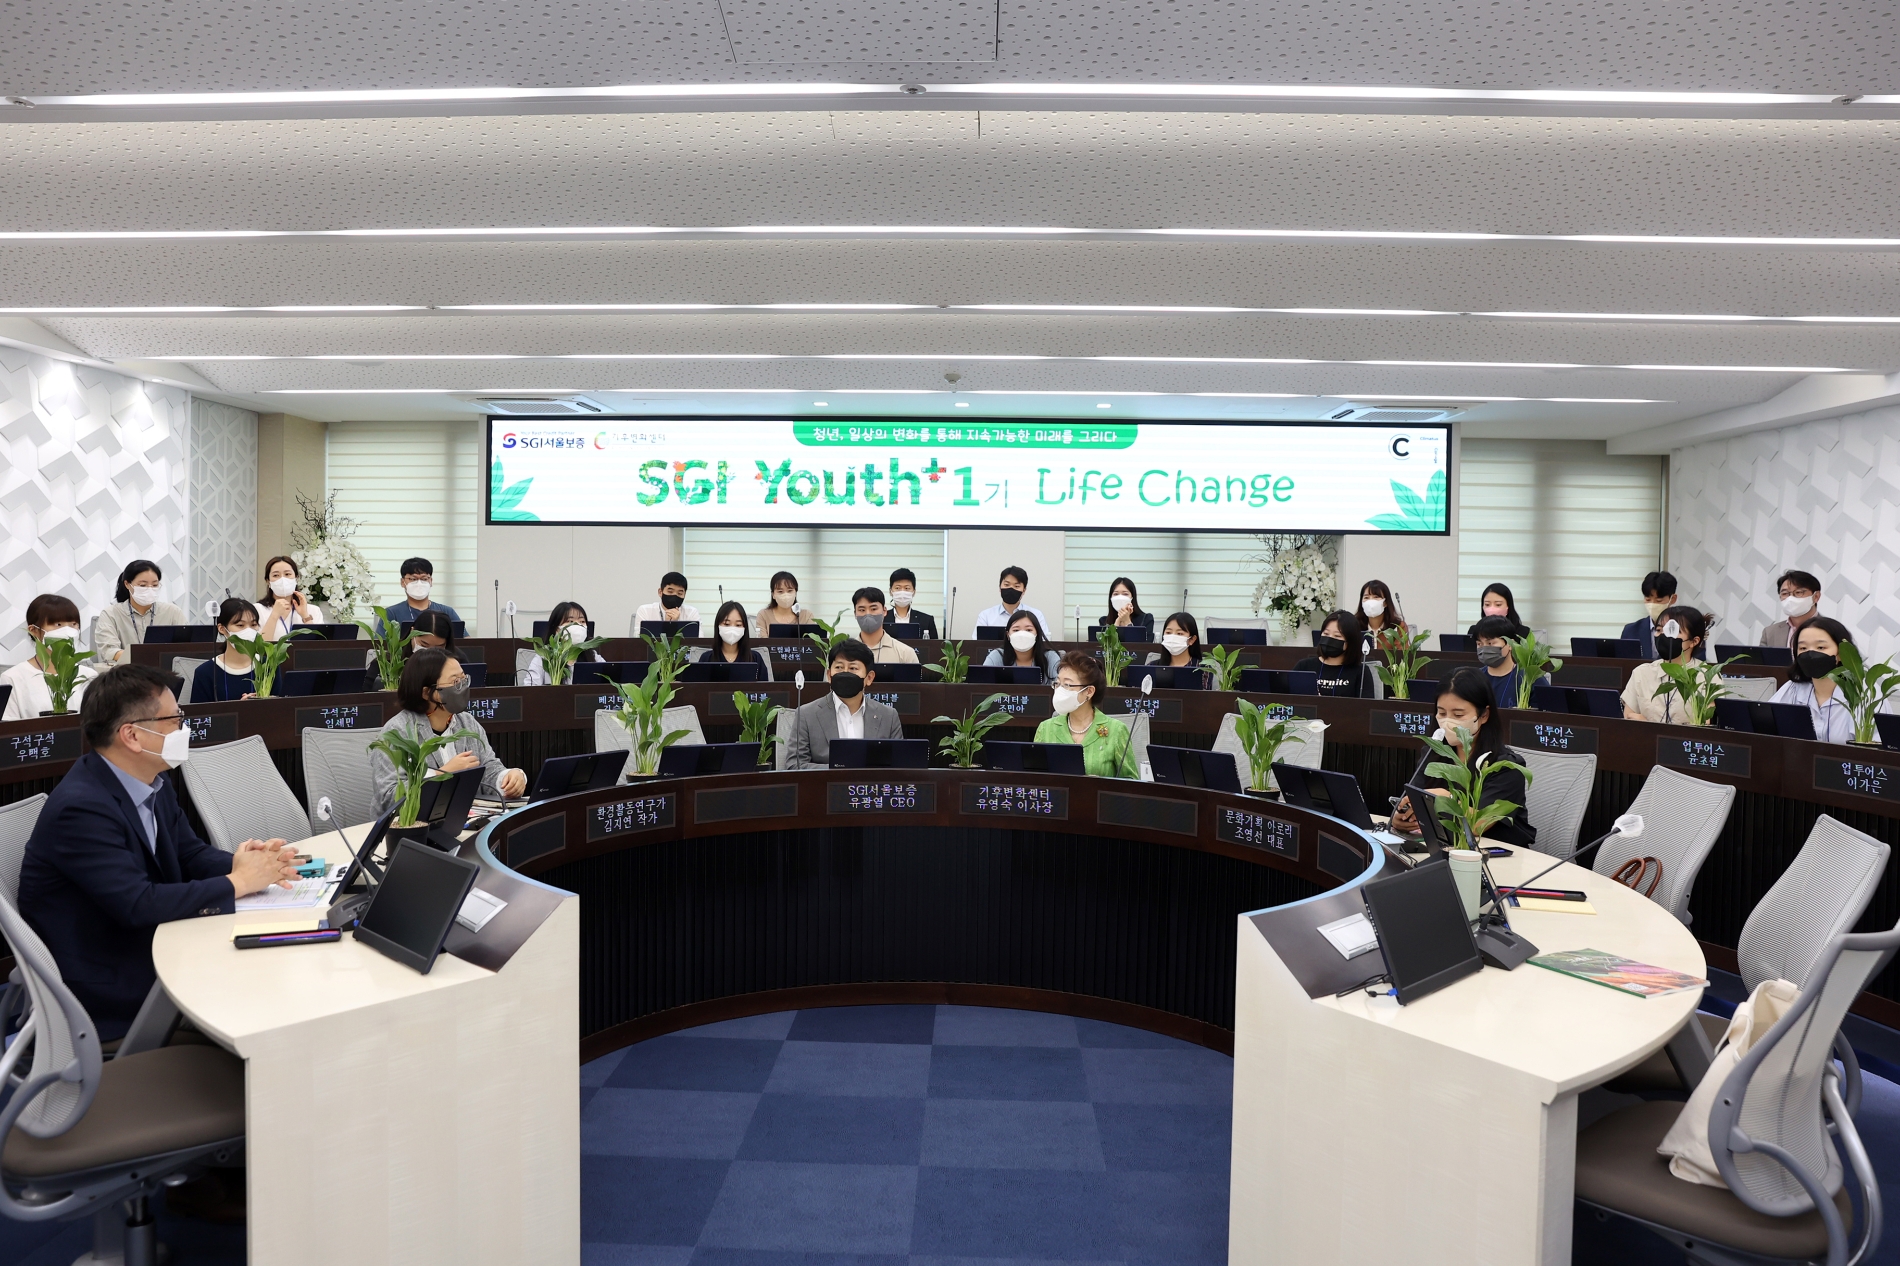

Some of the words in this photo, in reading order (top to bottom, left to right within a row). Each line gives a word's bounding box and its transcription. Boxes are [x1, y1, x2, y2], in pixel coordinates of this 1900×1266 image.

[520, 436, 585, 449] SGI서울보증
[813, 427, 844, 442] 청년,
[848, 427, 887, 442] 일상의
[892, 428, 931, 443] 변화를
[936, 428, 962, 443] 통해
[966, 429, 1030, 443] 지속가능한
[1035, 429, 1074, 444] 미래를
[1078, 430, 1117, 443] 그리다
[636, 459, 733, 506] SGI
[1034, 467, 1123, 506] Life
[1138, 469, 1295, 508] Change
[320, 705, 359, 719] 구석구석
[183, 716, 212, 729] 석구석
[190, 728, 207, 741] 주연
[1534, 724, 1575, 738] 업투어스
[10, 731, 55, 750] 구석구석
[1539, 736, 1568, 749] 박소영
[1682, 740, 1725, 756] 업투어스
[1688, 753, 1718, 768] 윤초원
[1841, 762, 1888, 781] 업투어스
[847, 783, 918, 797] SGI서울보증
[978, 785, 1050, 801] 기후변화센터
[1847, 776, 1882, 794] 이가은
[596, 796, 667, 821] 환경활동연구가
[848, 796, 883, 809] 유광열
[889, 796, 915, 808] CEO
[975, 798, 1013, 811] 유영숙
[1017, 799, 1054, 814] 이사장
[604, 815, 632, 833] 김지연
[637, 811, 658, 826] 작가
[1225, 809, 1263, 830] 문화기획
[1267, 819, 1292, 839] 아로리
[1234, 826, 1263, 844] 조영선
[1267, 834, 1285, 850] 대표
